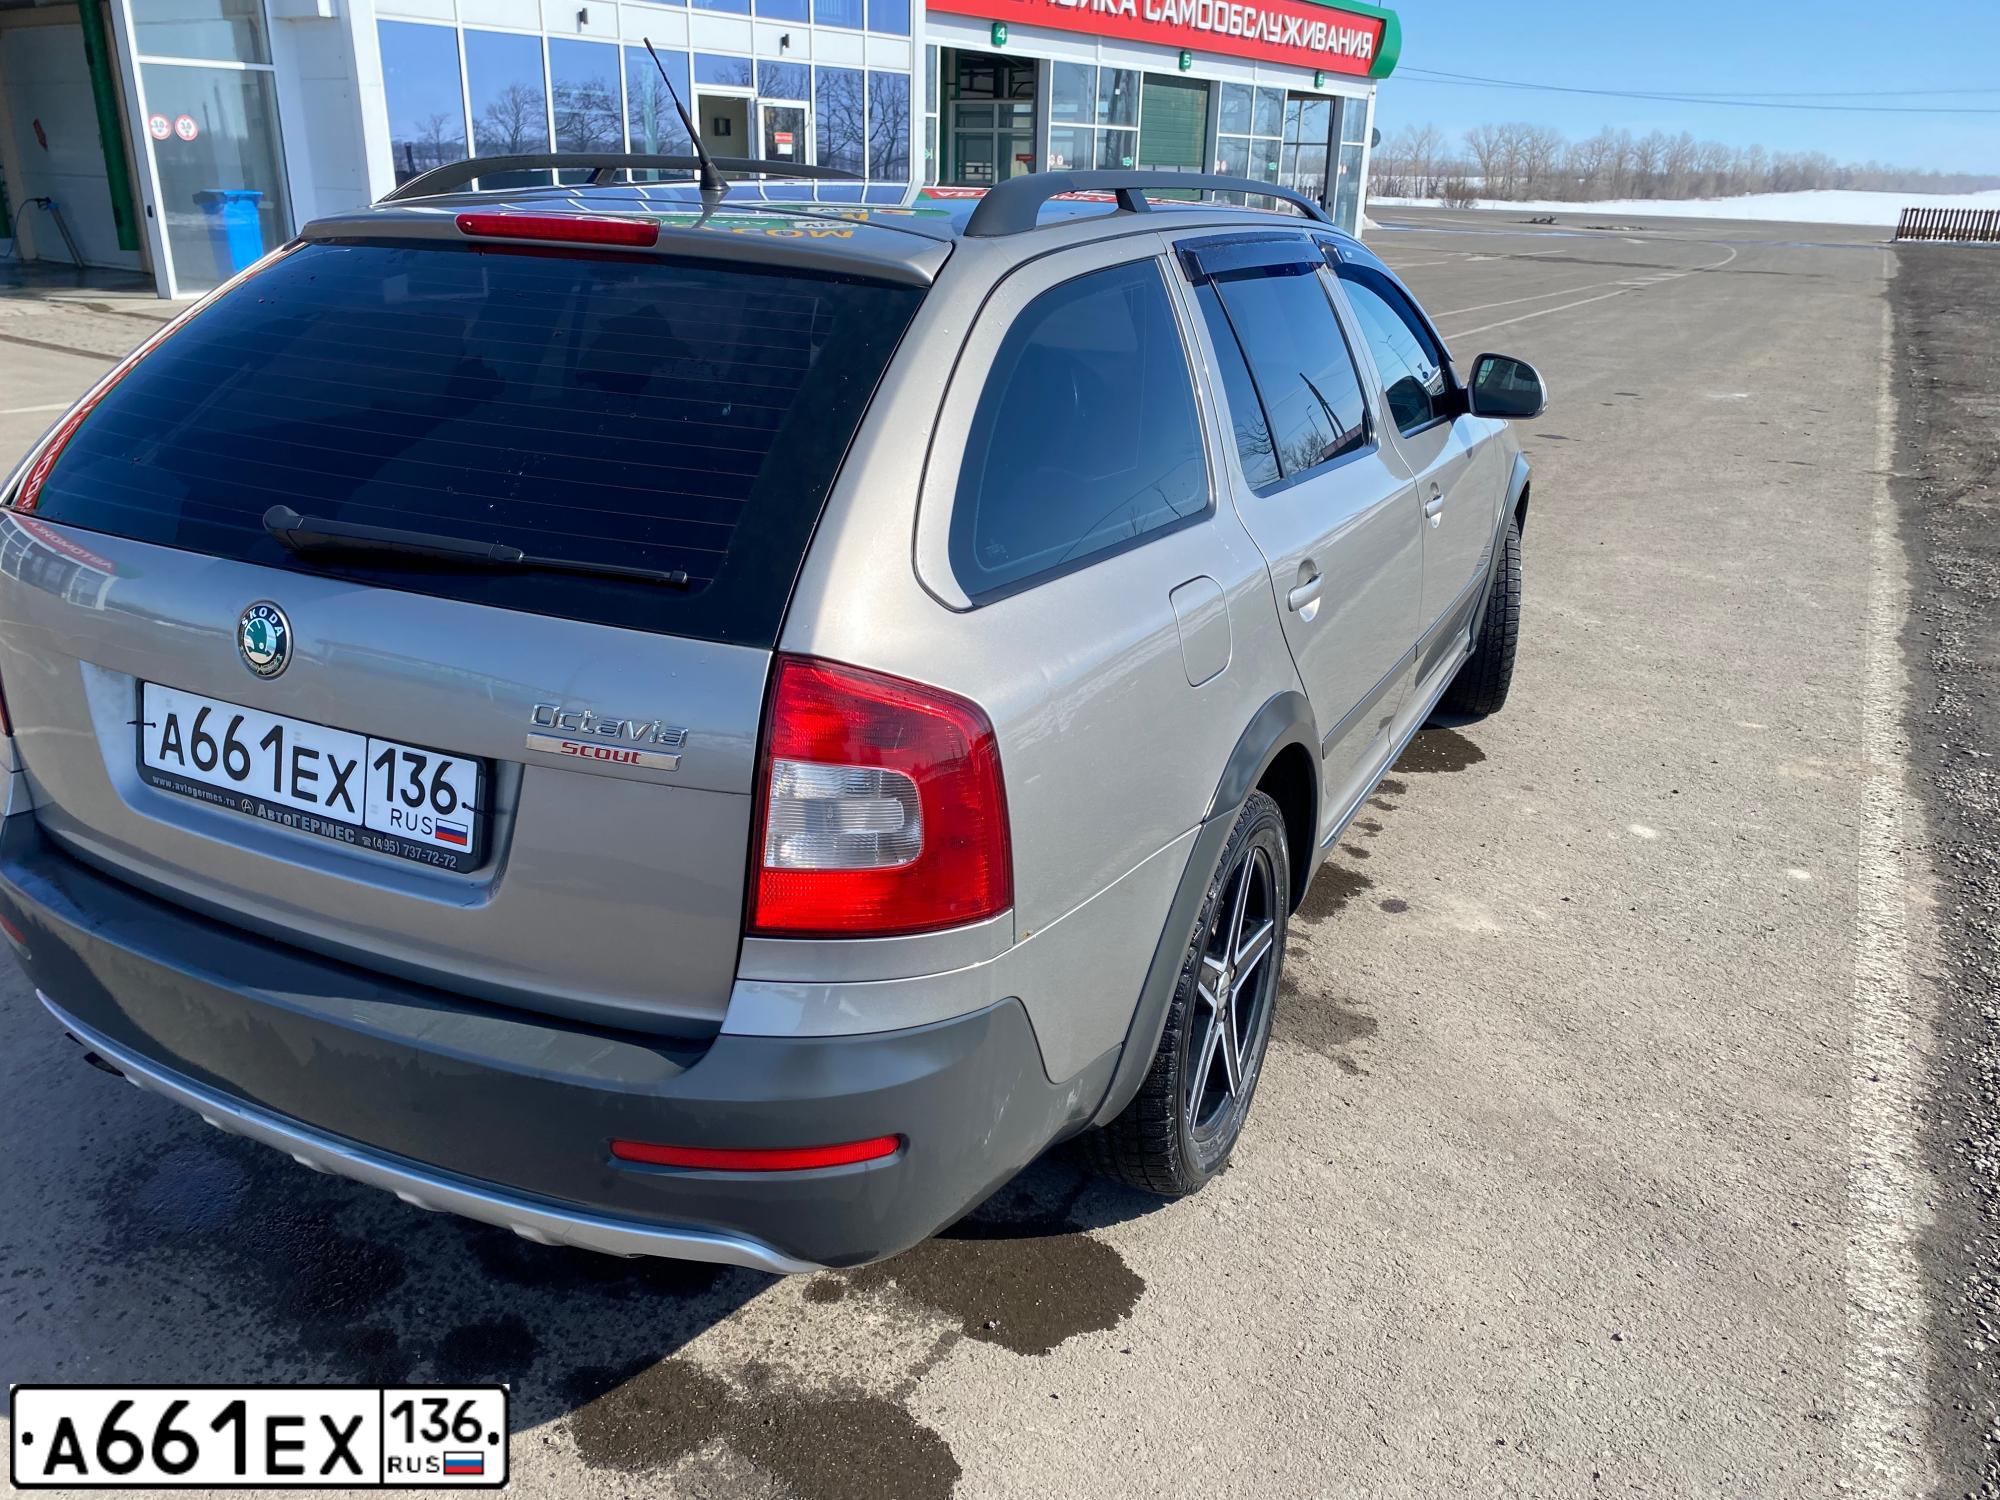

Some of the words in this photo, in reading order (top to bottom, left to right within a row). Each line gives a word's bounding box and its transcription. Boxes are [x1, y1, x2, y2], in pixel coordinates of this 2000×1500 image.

[997, 26, 1006, 41] 4
[1144, 0, 1373, 59] САМООБСЛУЖИВАНИЯ
[1183, 53, 1191, 66] 5
[530, 702, 689, 748] Octavia
[373, 748, 458, 815] 136
[390, 808, 433, 836] RUS
[372, 835, 400, 856] (495)
[403, 843, 457, 869] 737-72-72
